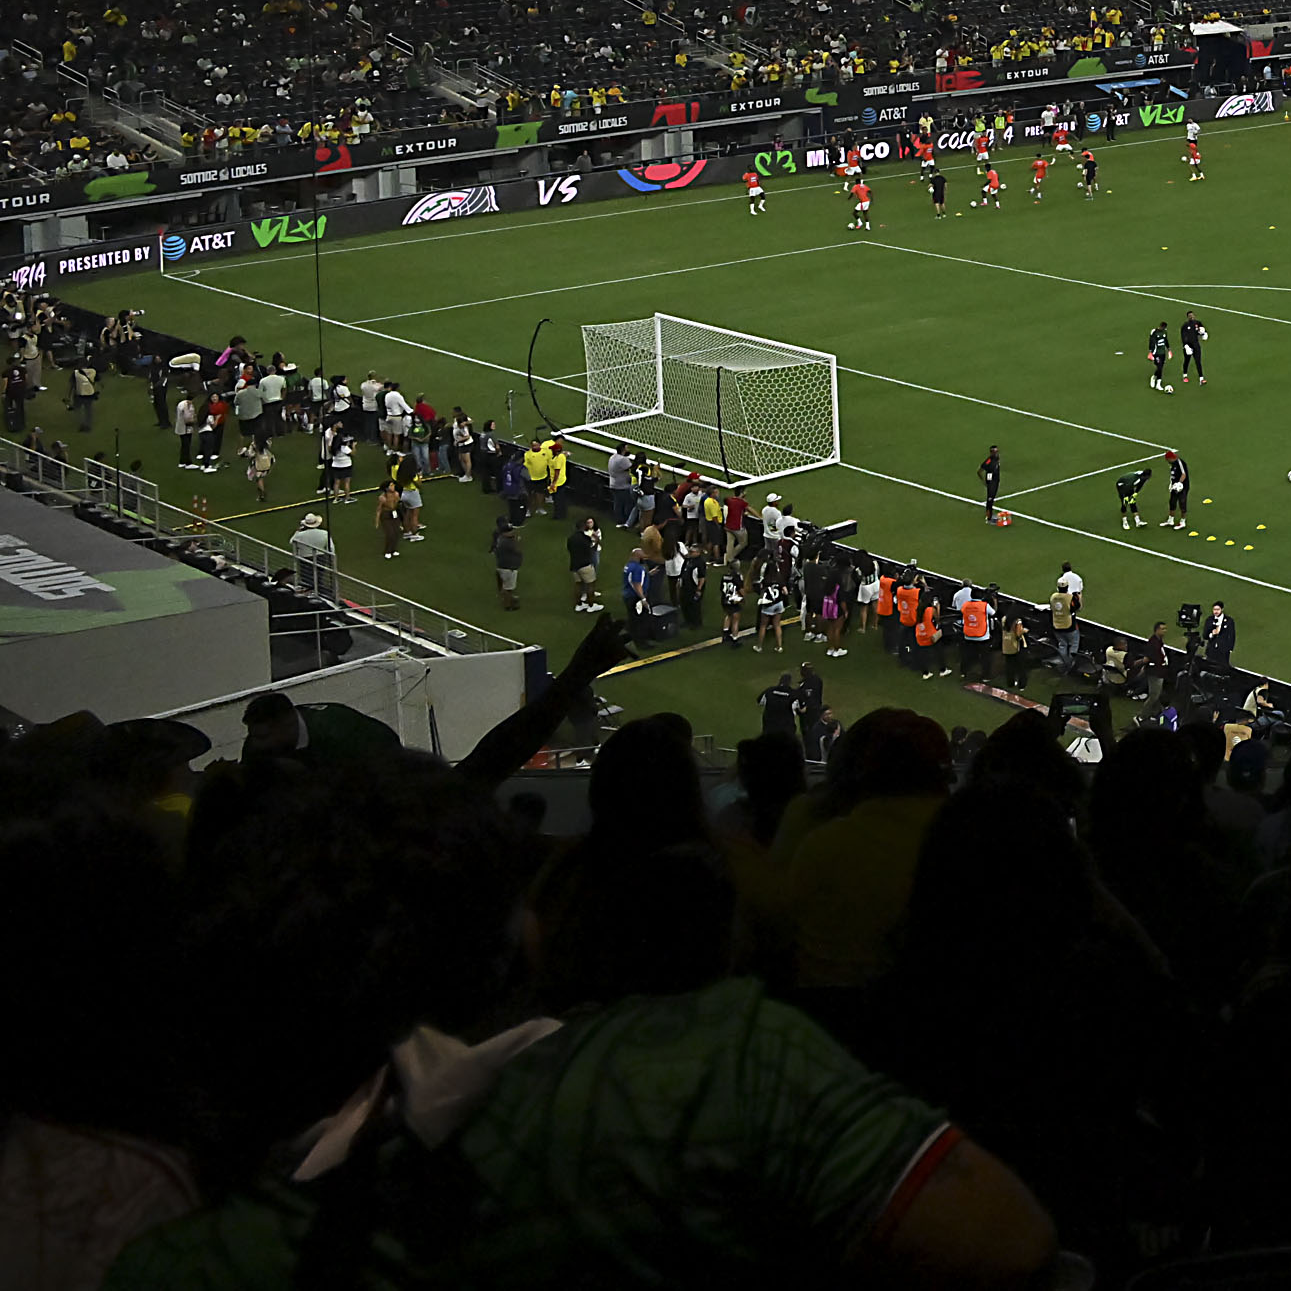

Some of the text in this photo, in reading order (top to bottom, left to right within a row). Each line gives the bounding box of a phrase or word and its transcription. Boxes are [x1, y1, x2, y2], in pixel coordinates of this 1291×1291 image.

[1148, 54, 1169, 66] AT&T
[878, 106, 908, 122] AT&T
[598, 115, 628, 130] LOCALES
[230, 163, 269, 180] LOCALES
[537, 174, 582, 206] VS
[58, 249, 130, 275] PRESENTED
[133, 245, 152, 264] BY
[189, 229, 236, 254] AT&T
